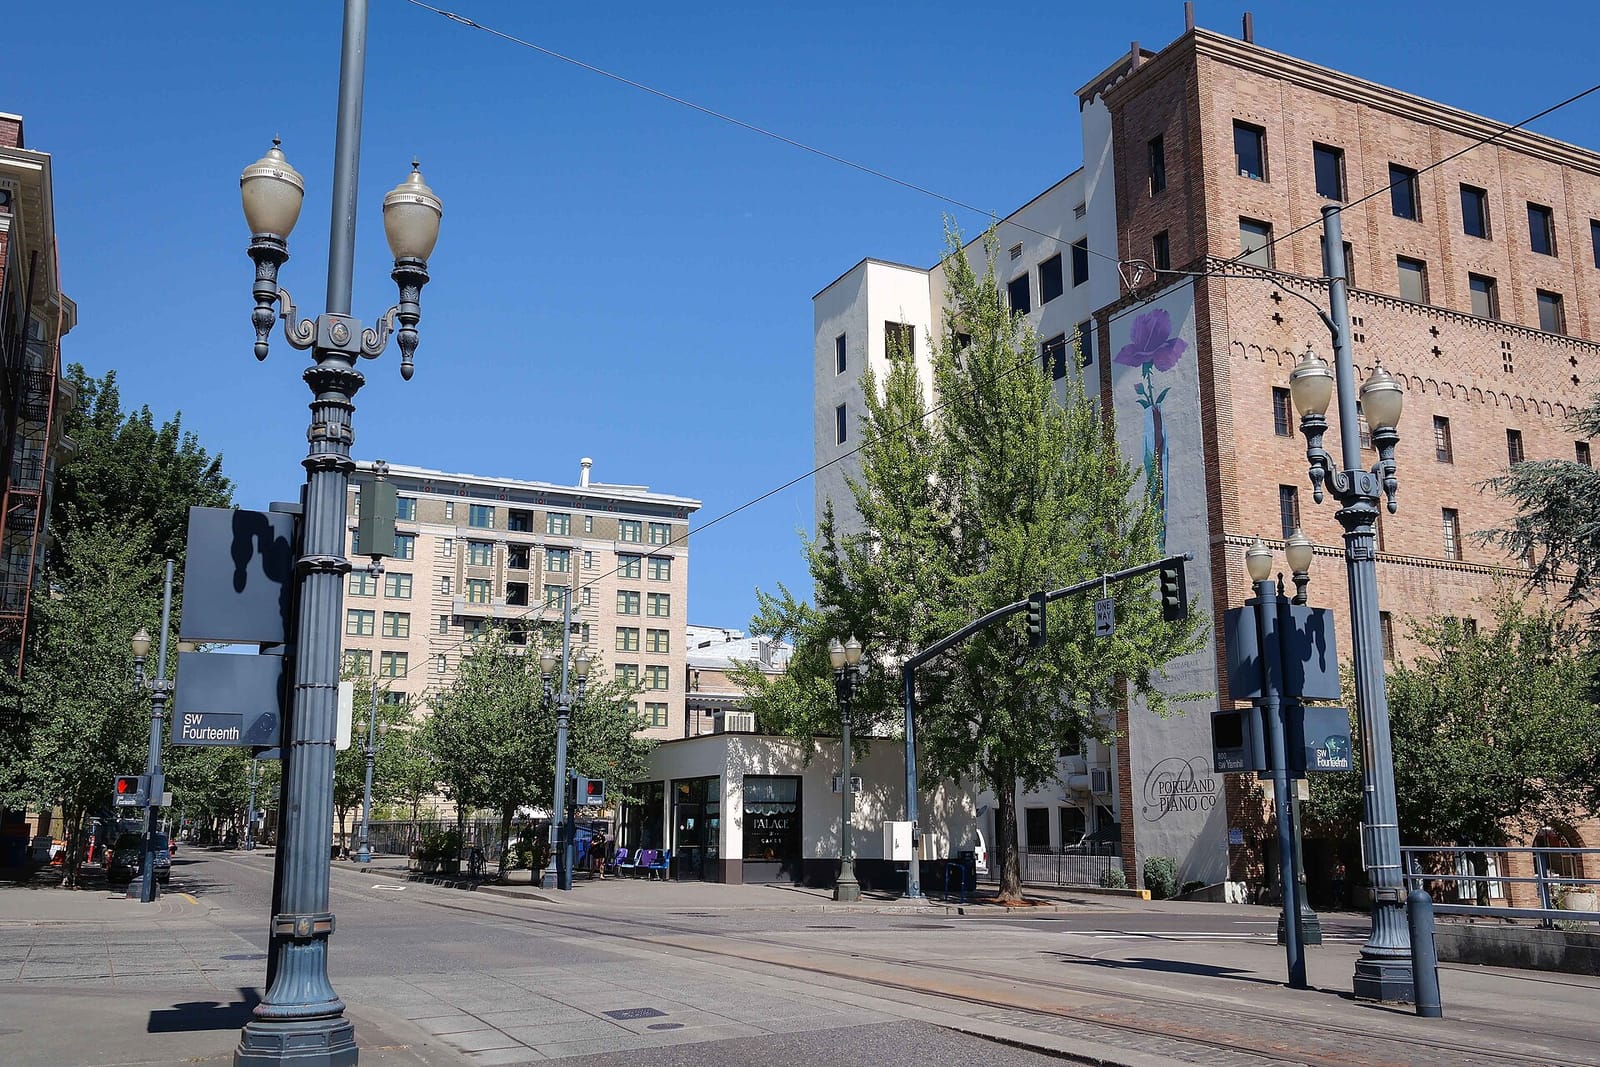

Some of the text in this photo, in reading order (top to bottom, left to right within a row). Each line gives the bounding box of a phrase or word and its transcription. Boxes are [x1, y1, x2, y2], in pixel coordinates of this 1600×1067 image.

[1097, 601, 1111, 611] ONE
[1097, 611, 1111, 621] WAY
[184, 714, 203, 725] SW
[183, 725, 239, 740] Fourteenth
[1317, 749, 1327, 758] SW
[1317, 757, 1348, 768] Fourteenth
[1159, 779, 1215, 794] PORTLAND
[1160, 796, 1198, 812] PIANO
[753, 818, 789, 829] PALACE
